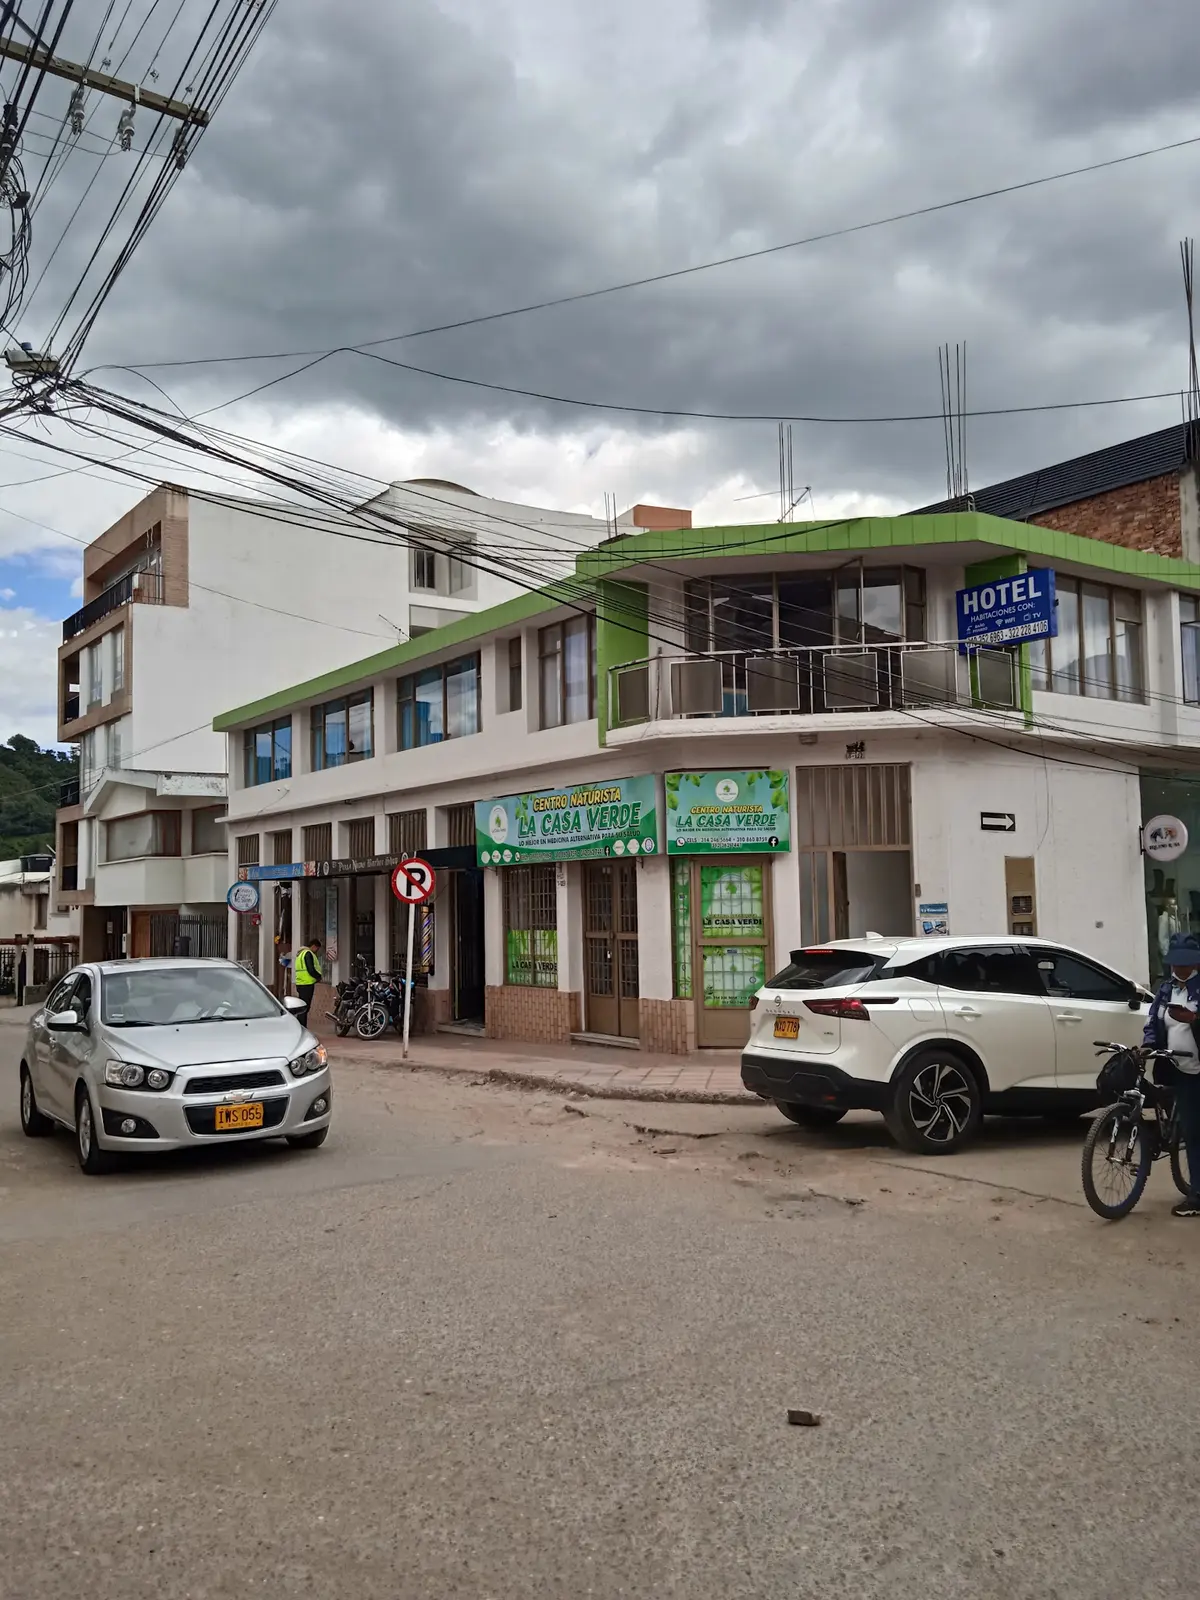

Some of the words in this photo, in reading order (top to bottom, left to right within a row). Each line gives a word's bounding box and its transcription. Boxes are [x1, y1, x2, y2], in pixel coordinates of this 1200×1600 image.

[963, 576, 1042, 615] HOTEL
[970, 605, 1016, 623] HABITACIONES
[1008, 627, 1020, 639] 322
[1032, 621, 1048, 633] 4106
[533, 794, 568, 812] CENTRO
[570, 786, 622, 808] NATURISTA
[690, 805, 720, 814] CENTRO
[721, 805, 763, 814] NATURISTA
[518, 815, 536, 838] LA
[541, 809, 581, 836] CASA
[587, 801, 642, 831] VERDE
[676, 815, 692, 828] LA
[696, 815, 730, 827] CASA
[735, 814, 777, 827] VERDE
[570, 834, 600, 842] ALTERNATIVA
[406, 868, 426, 896] P
[219, 1109, 238, 1124] IWS
[241, 1107, 261, 1121] 055
